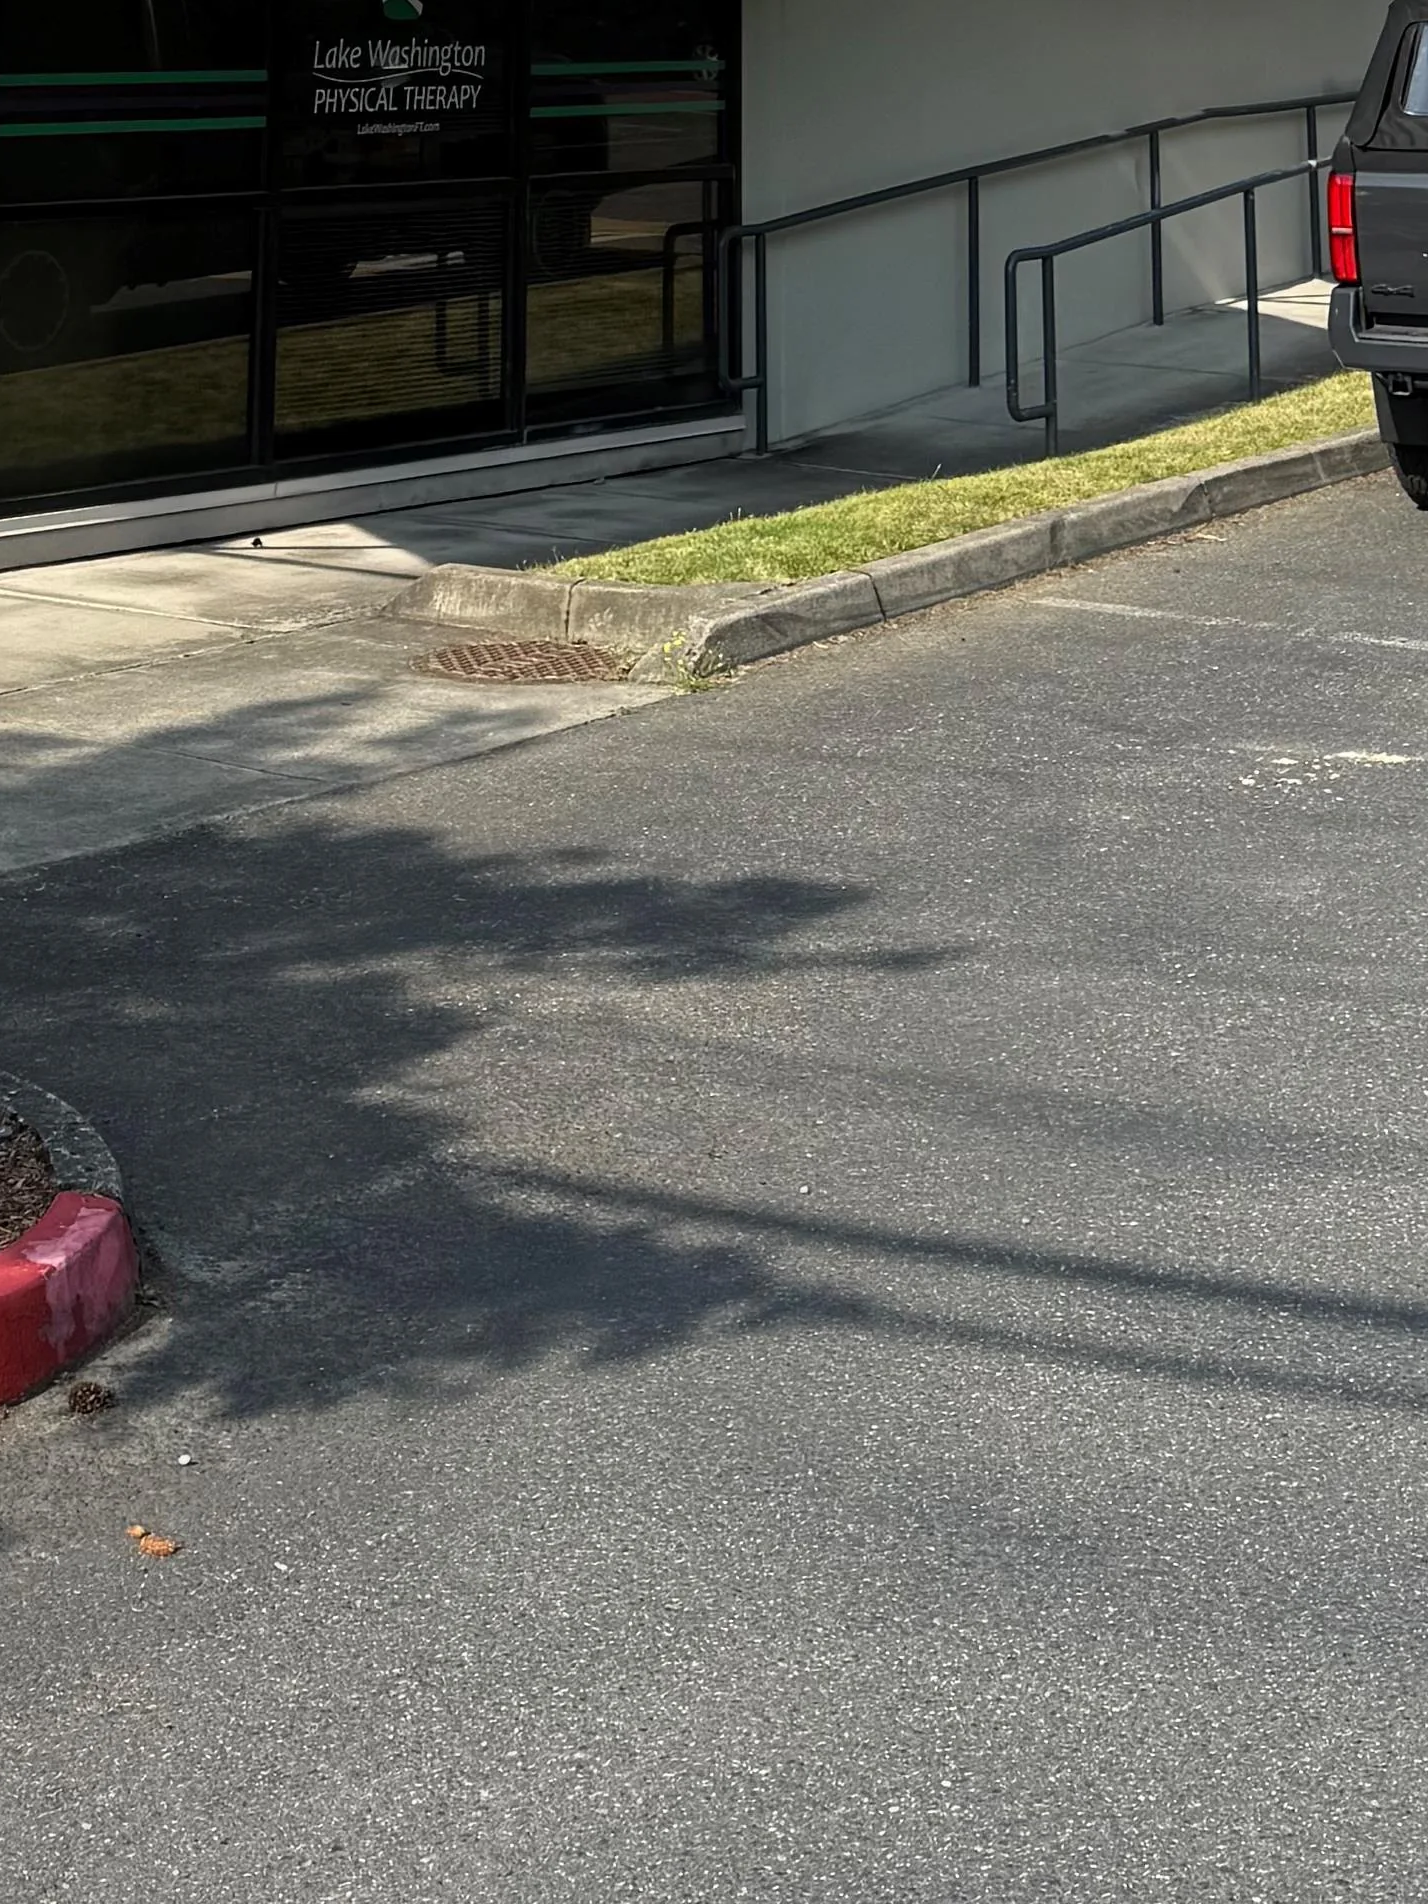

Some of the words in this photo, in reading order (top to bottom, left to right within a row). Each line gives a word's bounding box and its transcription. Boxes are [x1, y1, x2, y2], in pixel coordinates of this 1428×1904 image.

[313, 38, 362, 69] Lake
[369, 37, 486, 76] Washington
[313, 87, 399, 114] PHYSICAL
[404, 85, 482, 111] THERAPY
